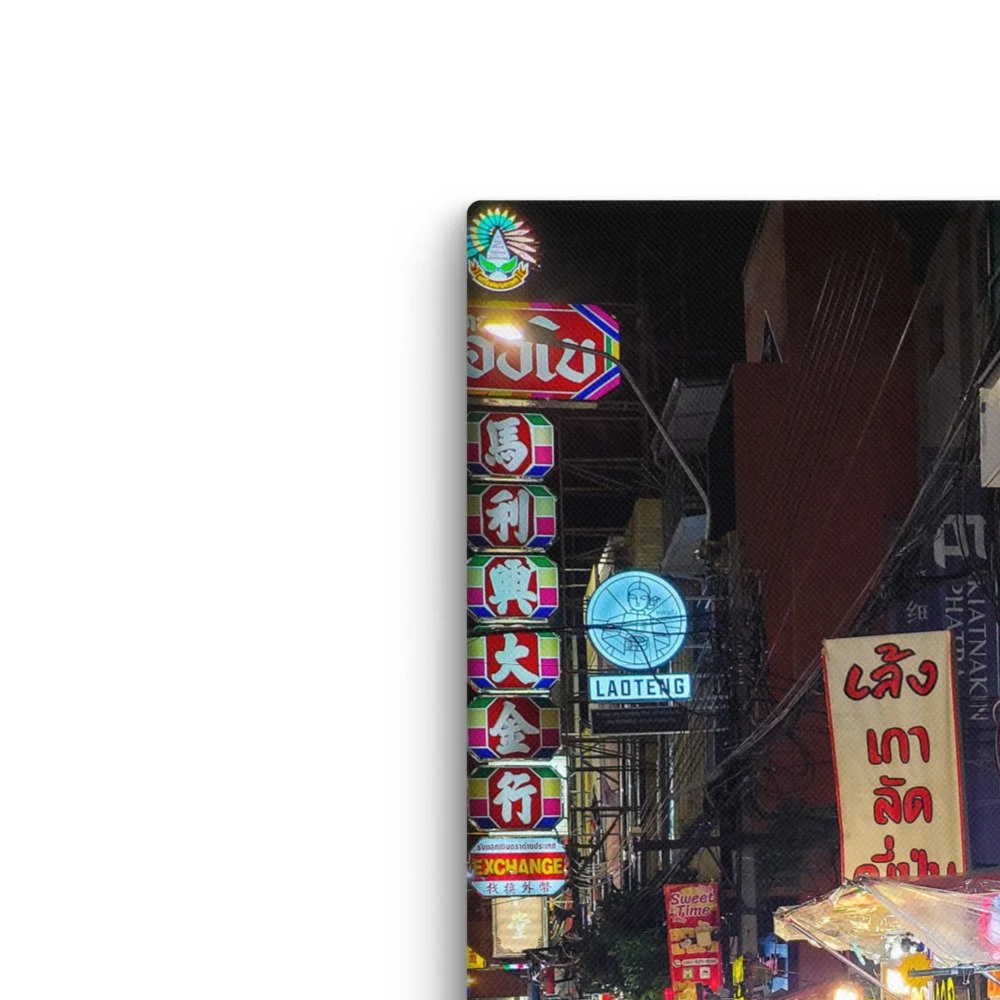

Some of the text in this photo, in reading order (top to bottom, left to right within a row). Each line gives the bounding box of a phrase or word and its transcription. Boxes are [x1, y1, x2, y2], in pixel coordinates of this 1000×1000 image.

[843, 642, 938, 701] เล้ง
[596, 678, 685, 698] LAOTENG
[866, 726, 930, 765] เกา
[873, 775, 934, 825] ลัด
[472, 857, 563, 876] EXCHANGE
[671, 891, 715, 905] Sweet
[676, 904, 711, 917] Time
